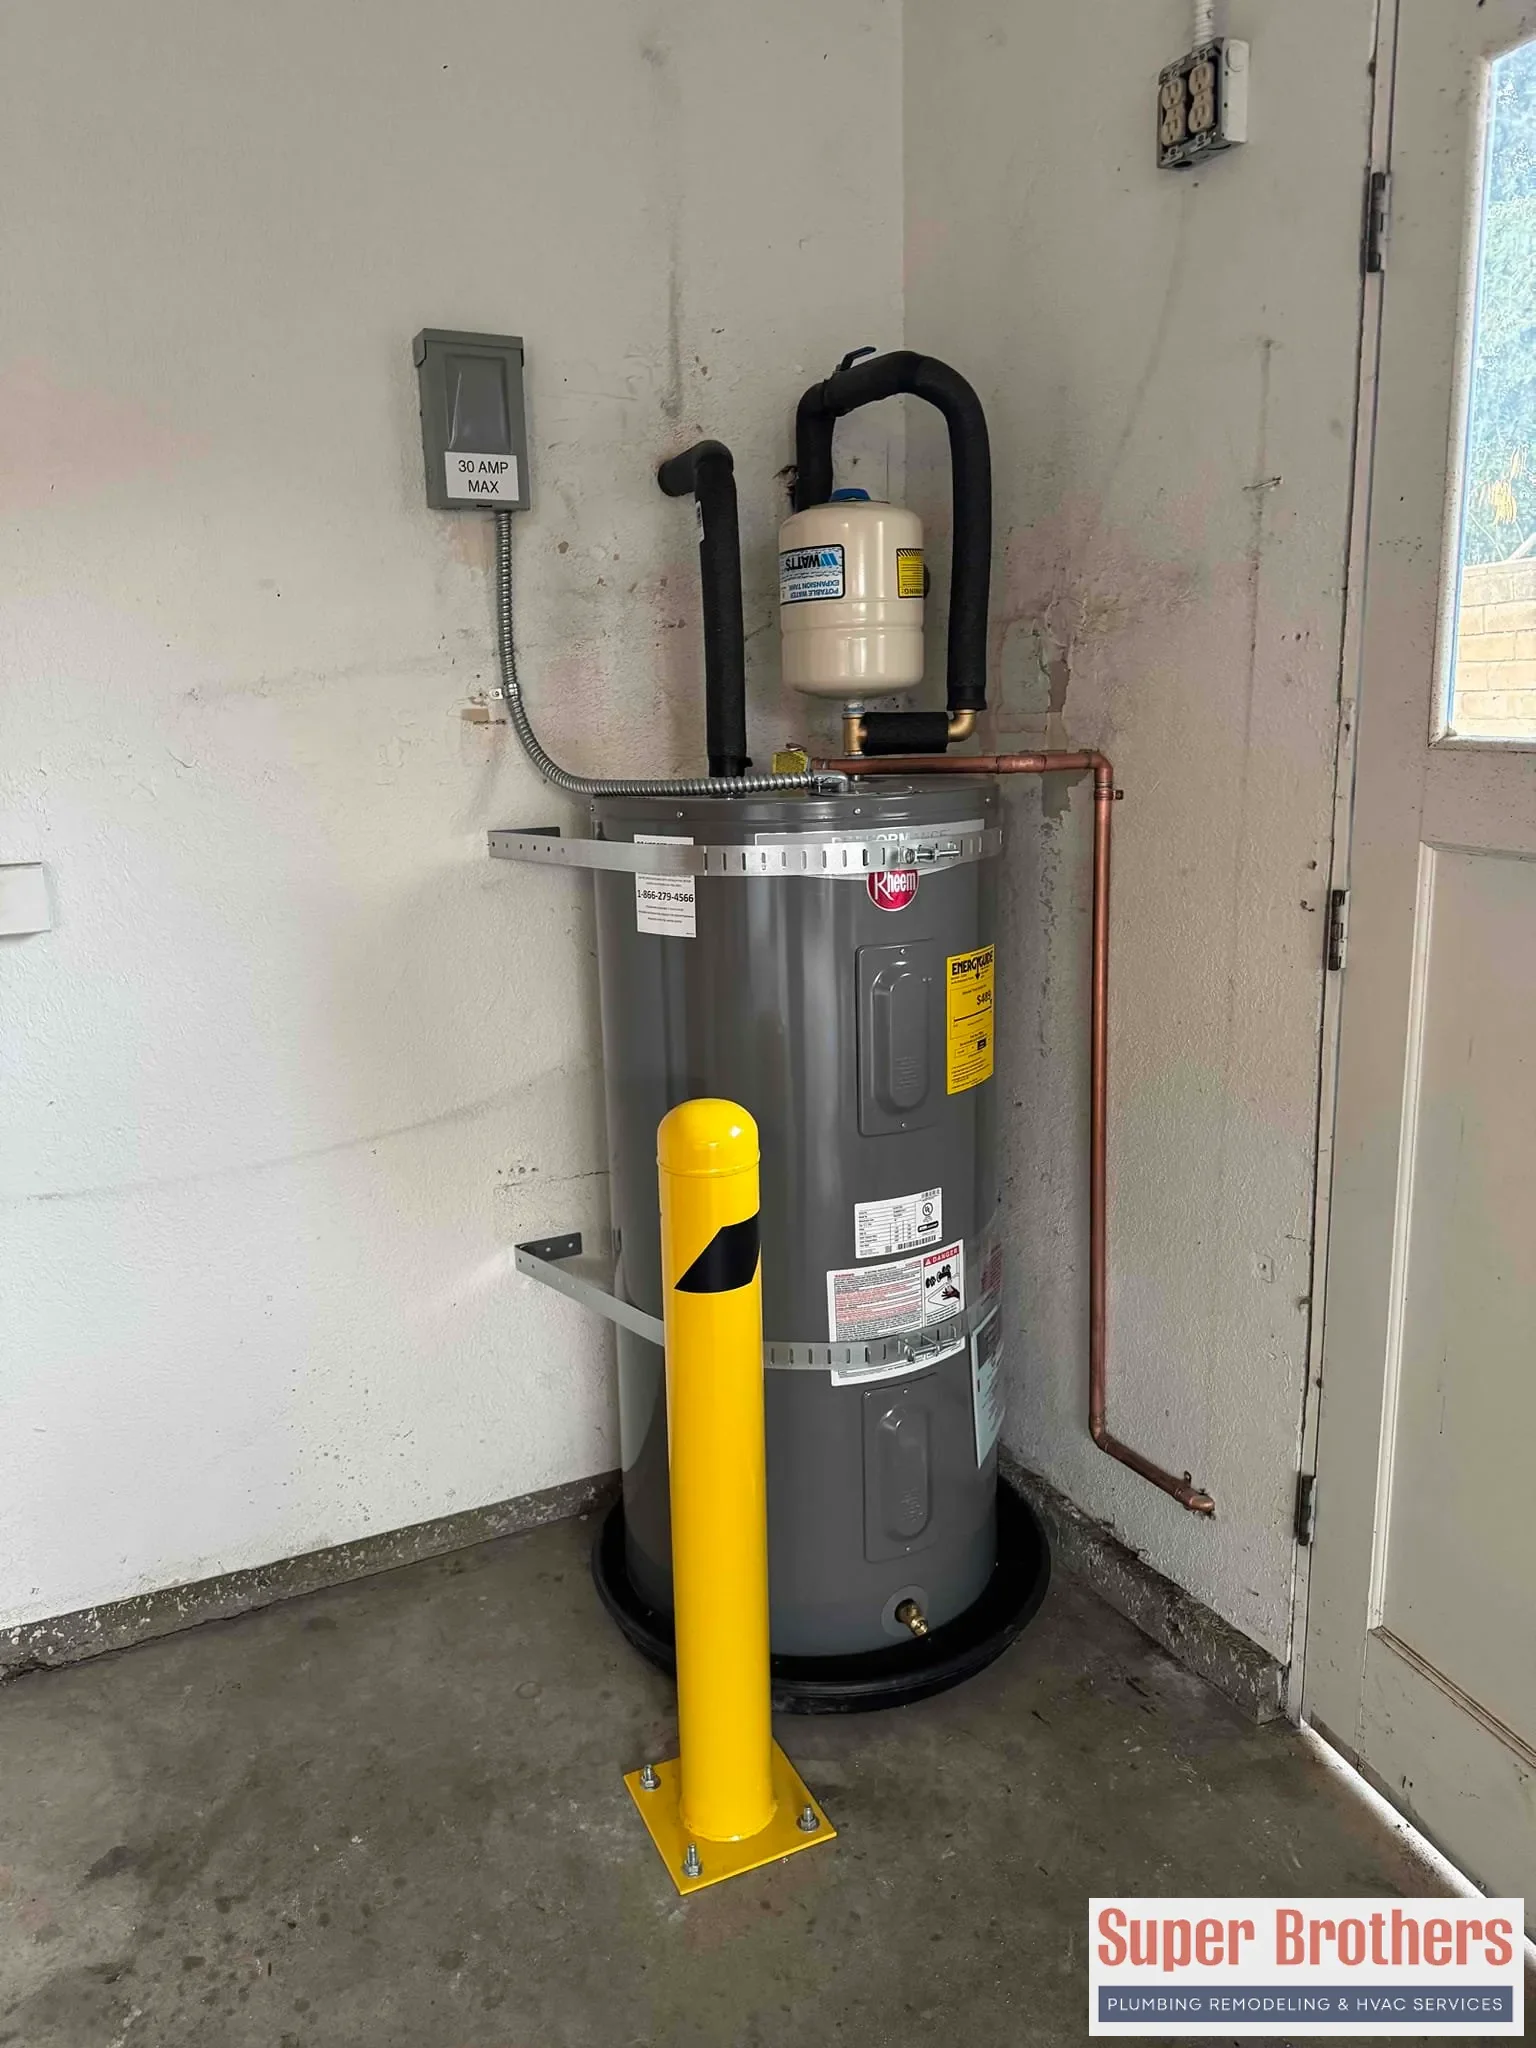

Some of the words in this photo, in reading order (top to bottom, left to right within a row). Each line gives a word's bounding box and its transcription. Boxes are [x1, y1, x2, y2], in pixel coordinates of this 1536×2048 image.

[458, 459, 475, 473] 30
[478, 461, 509, 474] AMP
[468, 479, 500, 494] MAX
[785, 554, 820, 572] WATTS
[874, 870, 917, 901] Rheem
[637, 889, 694, 903] 1-866-279-4566
[932, 1247, 958, 1263] DANGER
